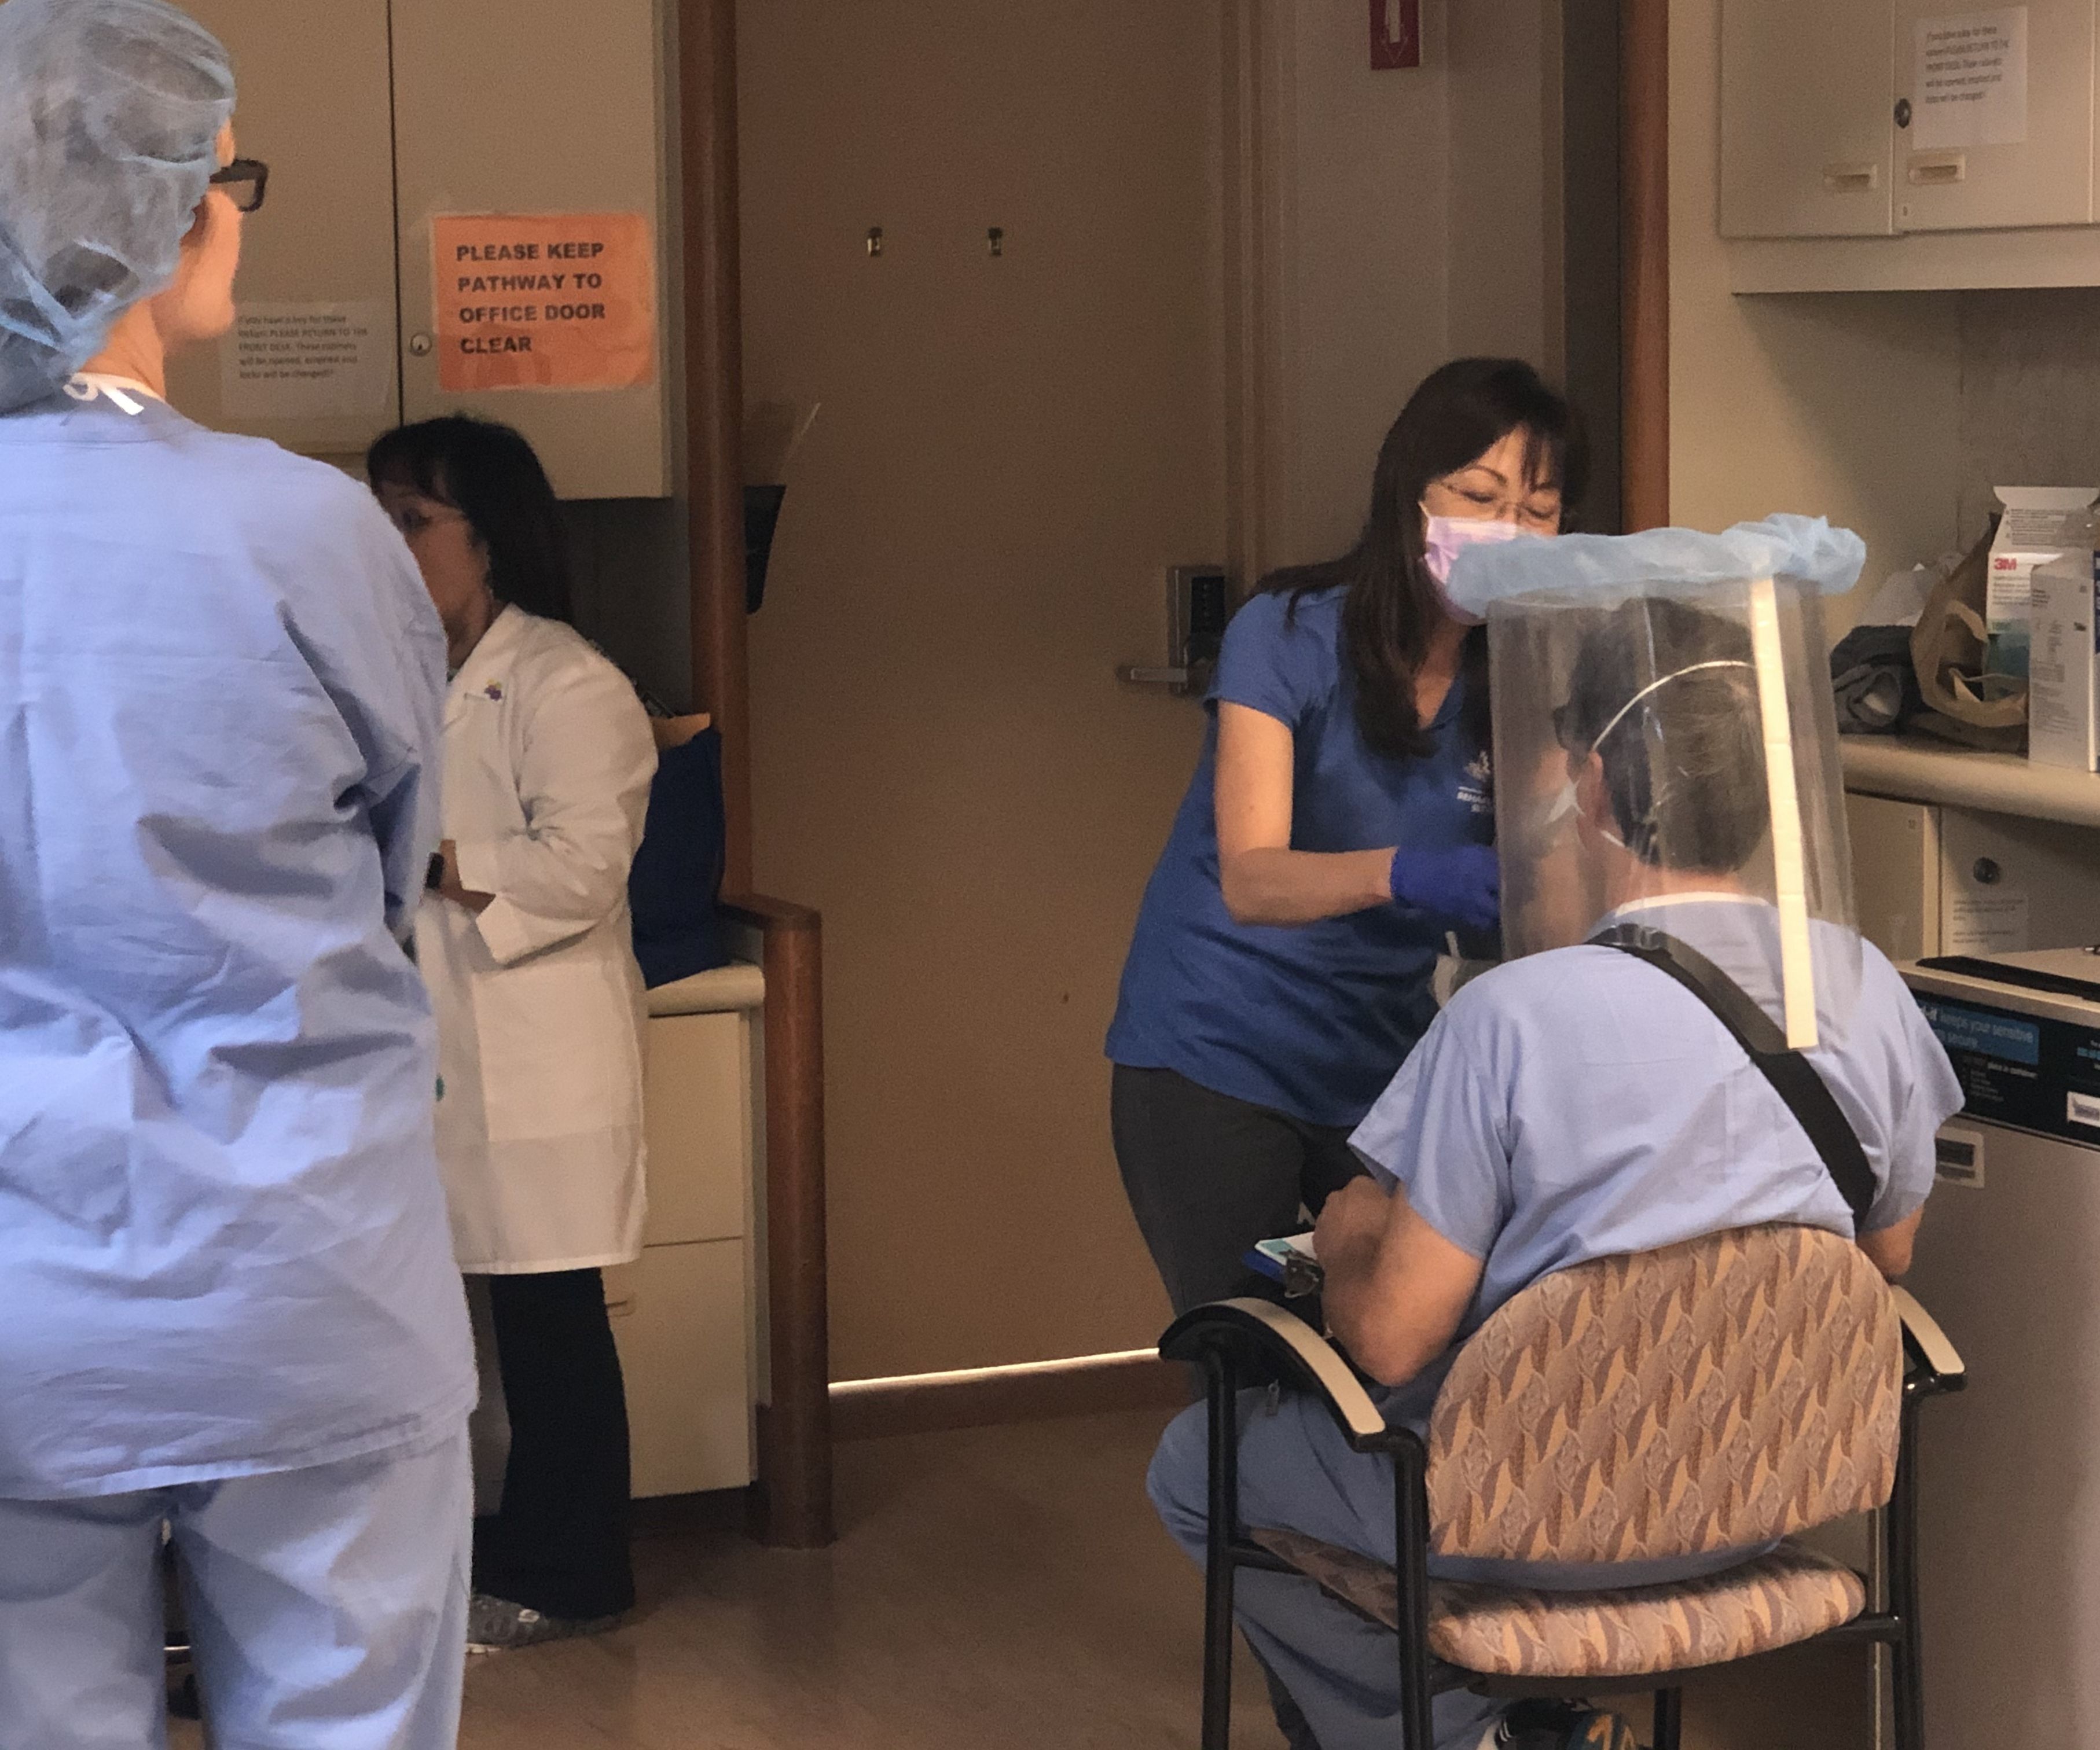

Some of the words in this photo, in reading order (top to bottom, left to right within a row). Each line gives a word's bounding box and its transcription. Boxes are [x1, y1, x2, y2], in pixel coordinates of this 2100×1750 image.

[457, 244, 539, 261] PLEASE
[548, 242, 604, 259] KEEP
[457, 274, 566, 292] PATHWAY
[573, 273, 602, 289] TO
[459, 305, 538, 323] OFFICE
[545, 303, 605, 320] DOOR
[460, 336, 533, 354] CLEAR
[1993, 557, 2017, 571] 3M
